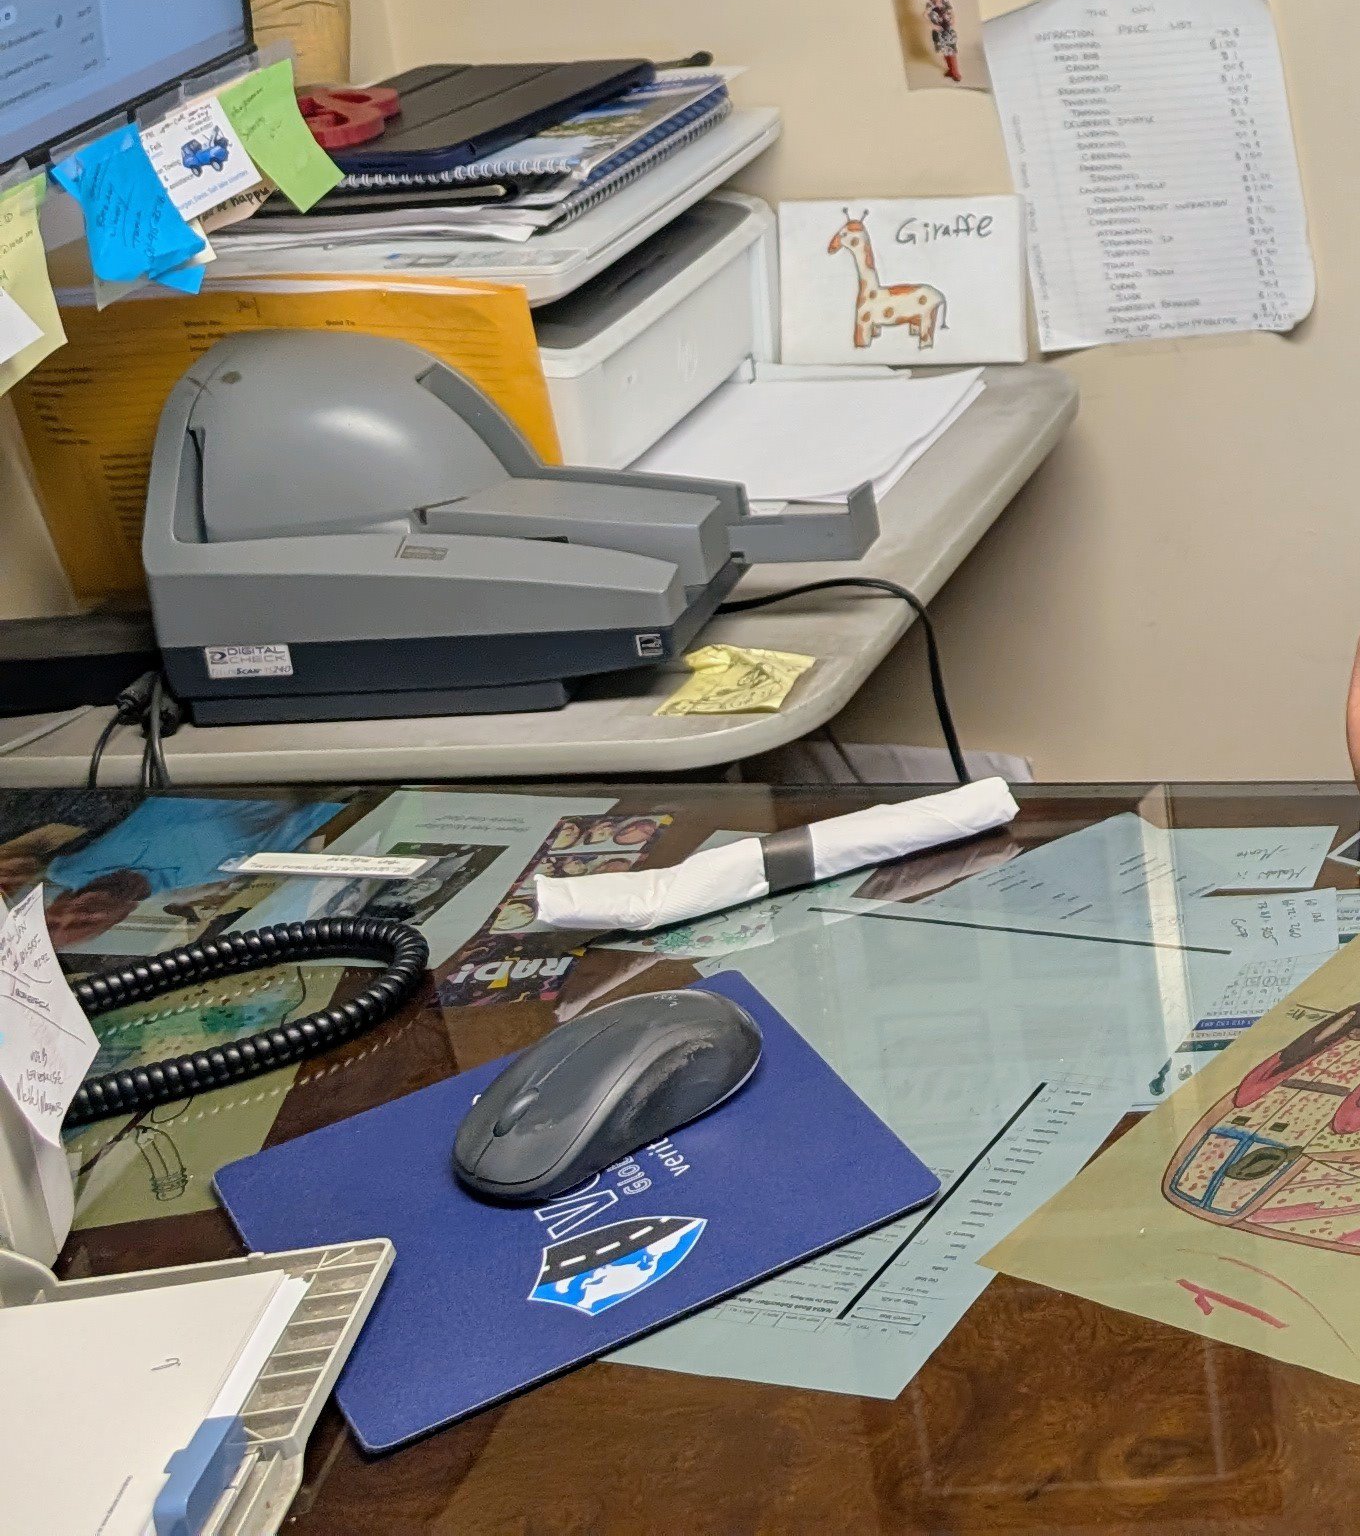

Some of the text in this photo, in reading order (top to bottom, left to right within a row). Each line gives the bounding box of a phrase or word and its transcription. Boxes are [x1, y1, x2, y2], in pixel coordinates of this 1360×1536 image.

[896, 213, 993, 245] Giraffe
[227, 646, 285, 655] DIGITAL
[230, 654, 286, 663] CHECK
[456, 957, 574, 986] RAD!
